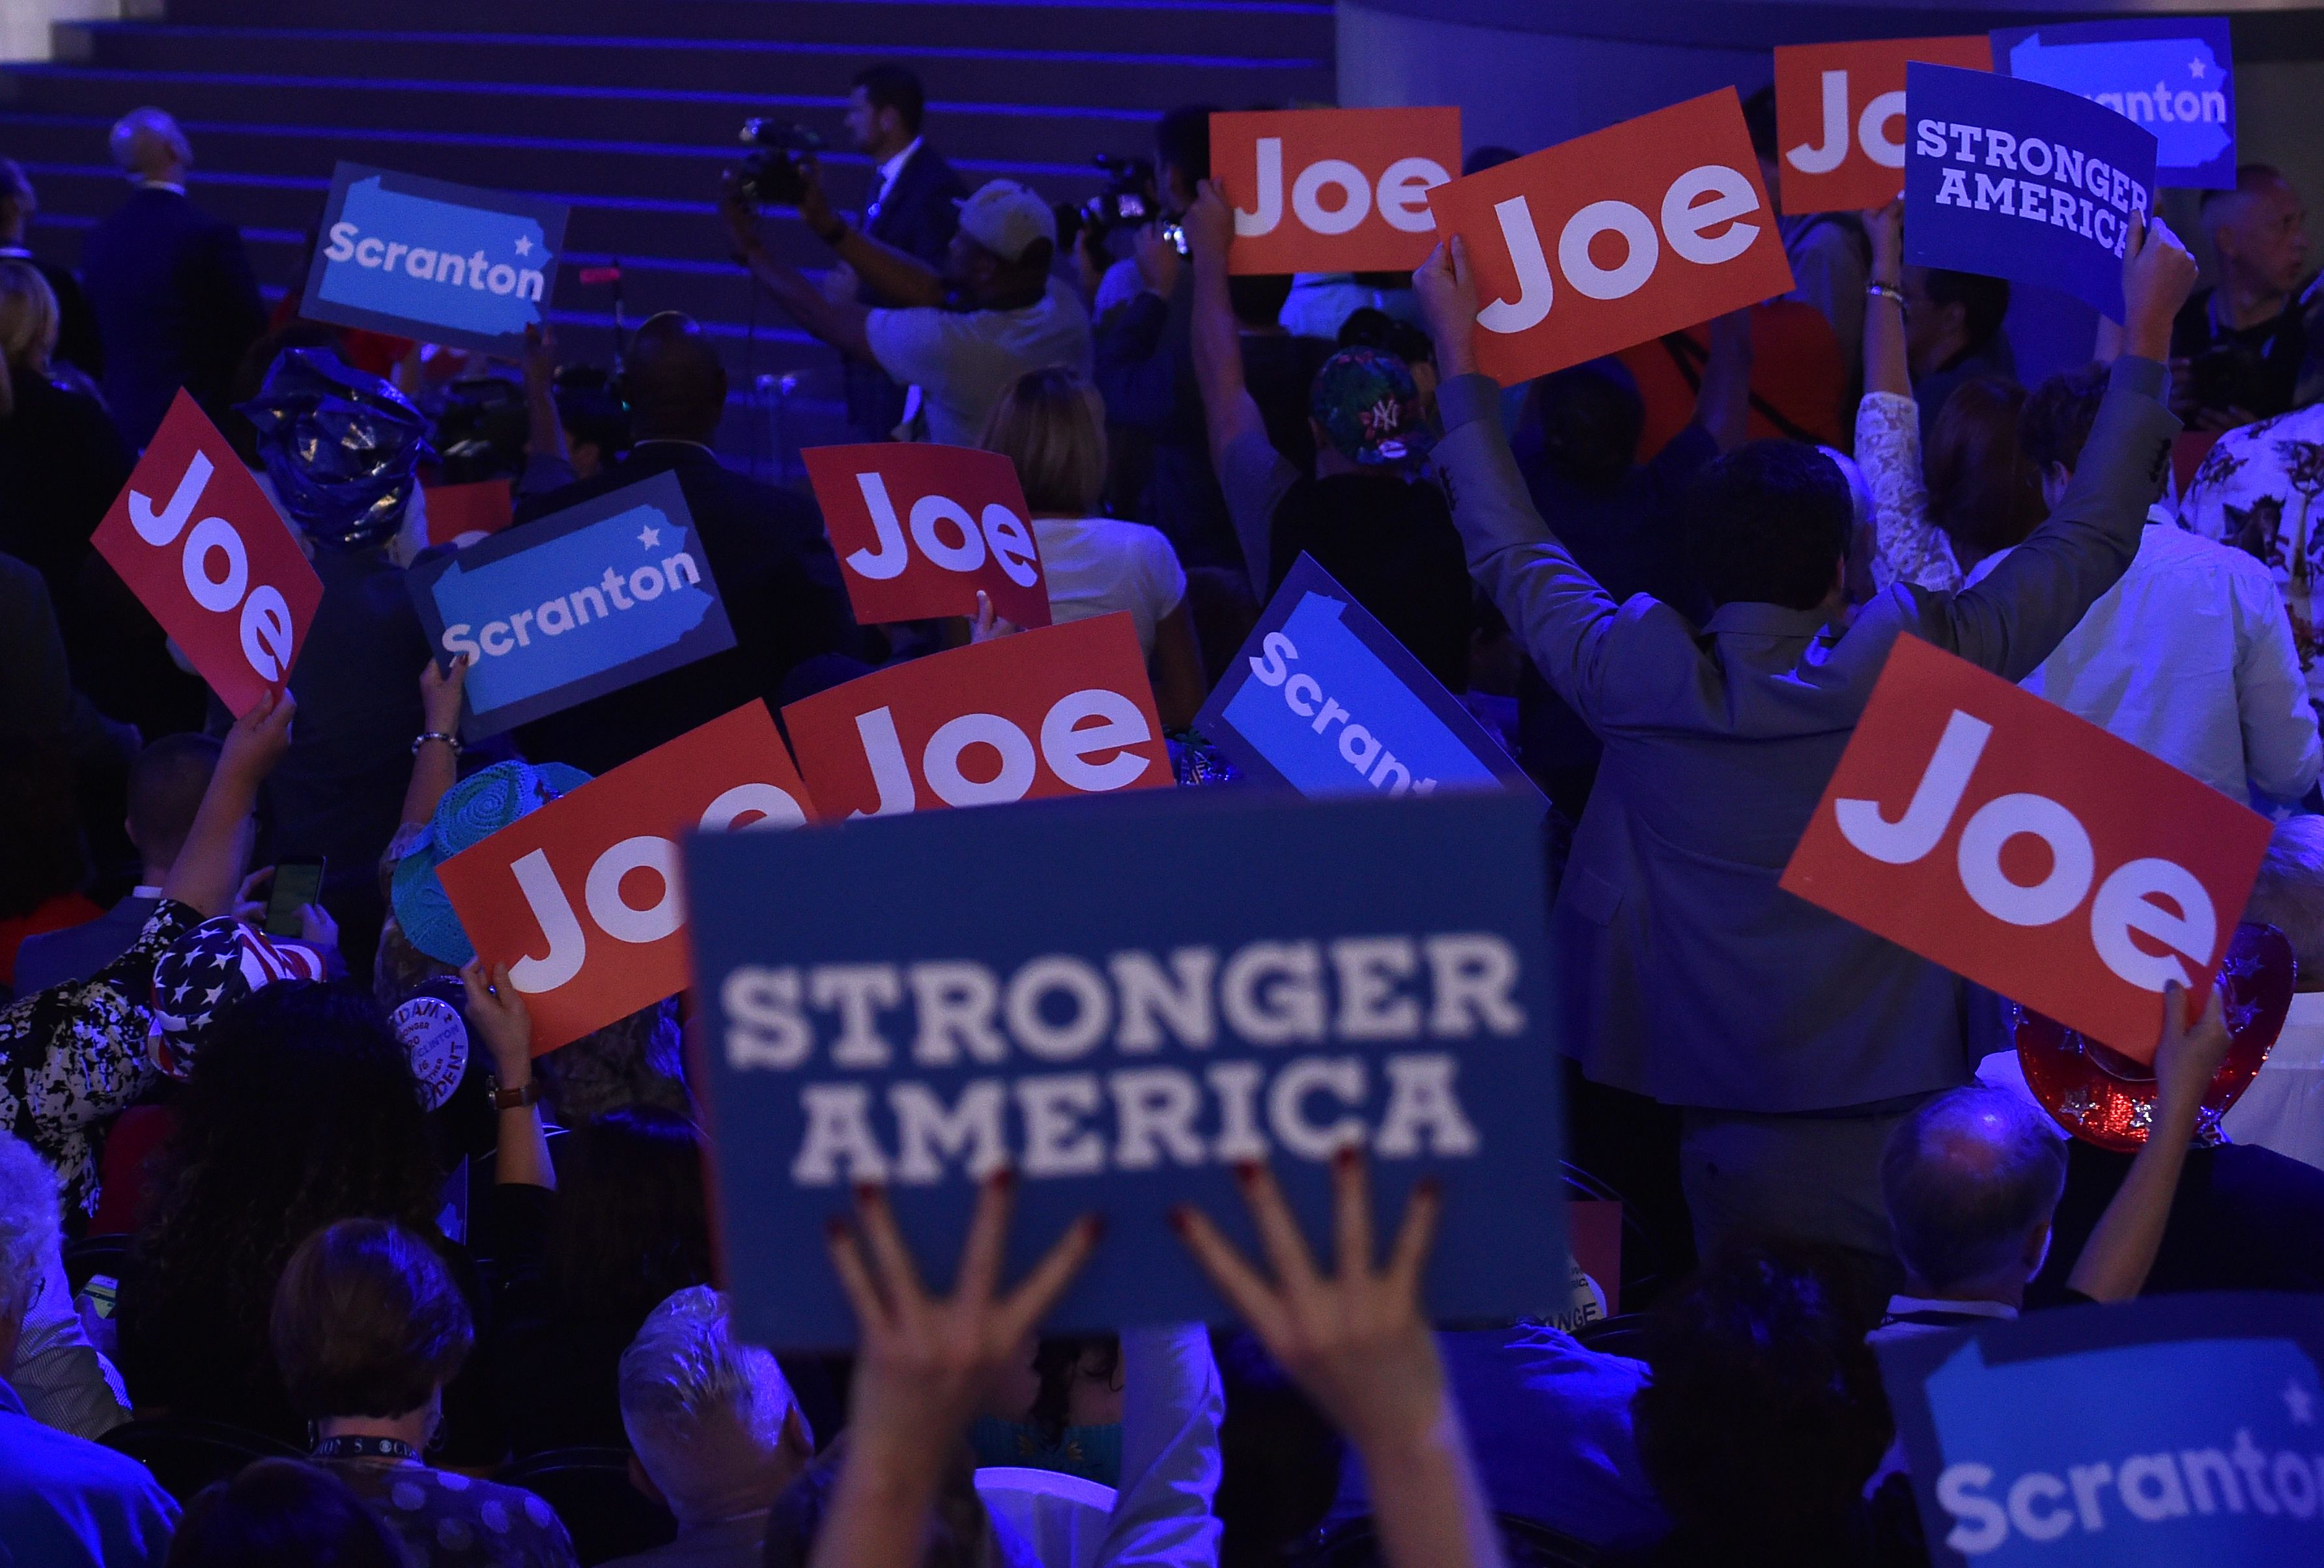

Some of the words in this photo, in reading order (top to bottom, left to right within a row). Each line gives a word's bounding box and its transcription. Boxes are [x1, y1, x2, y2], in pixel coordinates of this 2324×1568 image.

[1786, 70, 1906, 174] Jo
[2085, 79, 2226, 122] anton
[1235, 137, 1451, 237] Joe
[1916, 119, 2147, 228] STRONGER
[323, 221, 544, 301] Scranton
[1477, 165, 1761, 333] Joe
[128, 449, 293, 682] Joe
[845, 471, 1038, 587] Joe
[442, 552, 701, 667] Scranton
[845, 689, 1152, 820] Joe
[1249, 632, 1438, 796] Scran
[1835, 708, 2217, 993] Joe
[720, 933, 1525, 1069] STRONGER
[793, 1054, 1478, 1186] AMERICA
